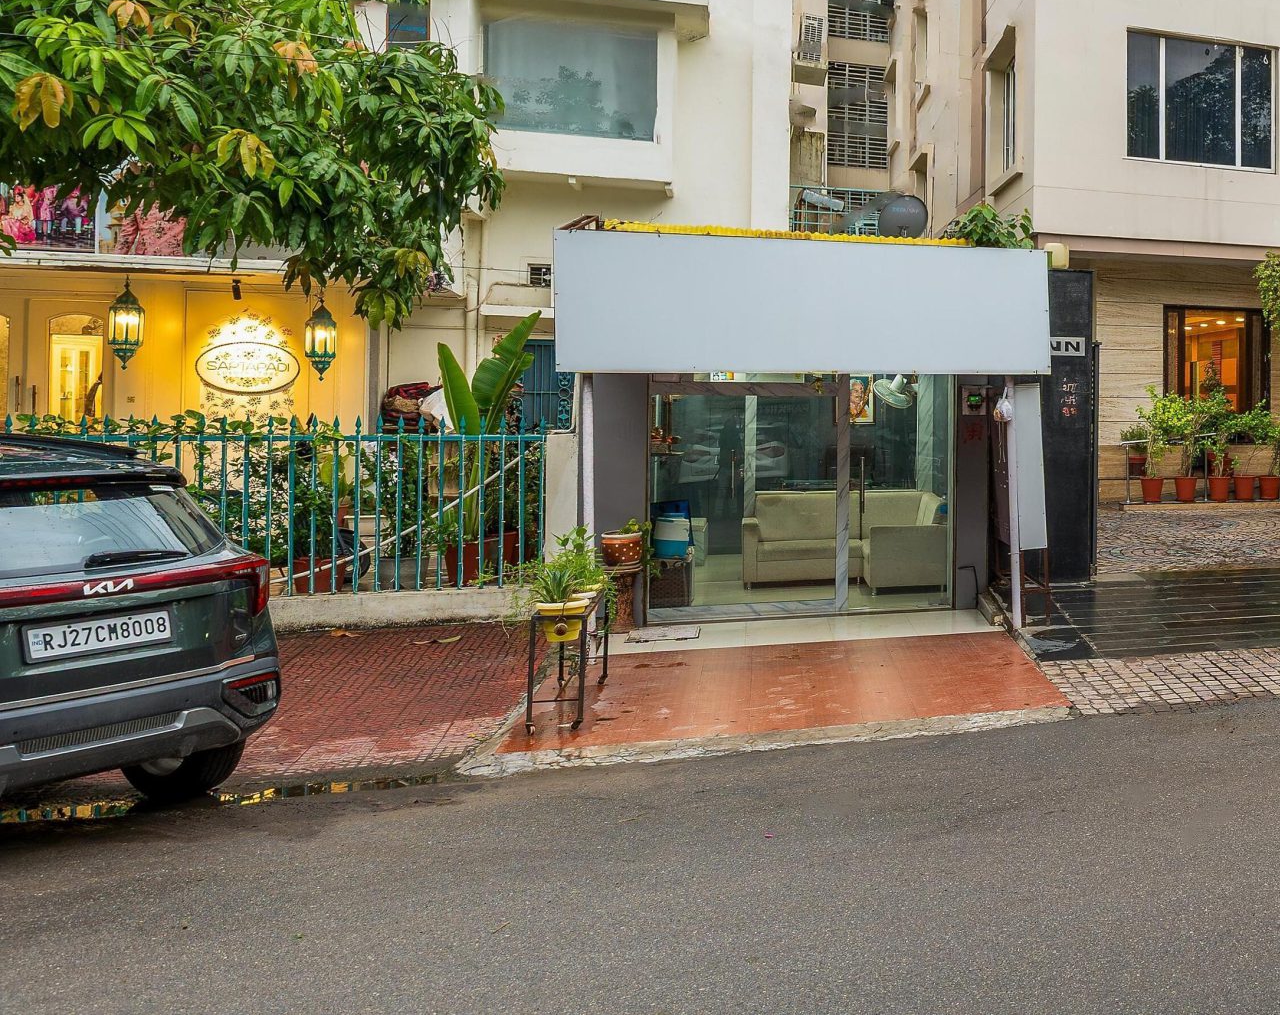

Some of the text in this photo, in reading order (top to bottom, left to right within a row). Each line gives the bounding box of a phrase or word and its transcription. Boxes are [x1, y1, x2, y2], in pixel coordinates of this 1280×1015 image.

[206, 360, 290, 373] SAPTAPADI
[83, 578, 134, 596] KIA
[43, 616, 167, 652] RJ27CM8008
